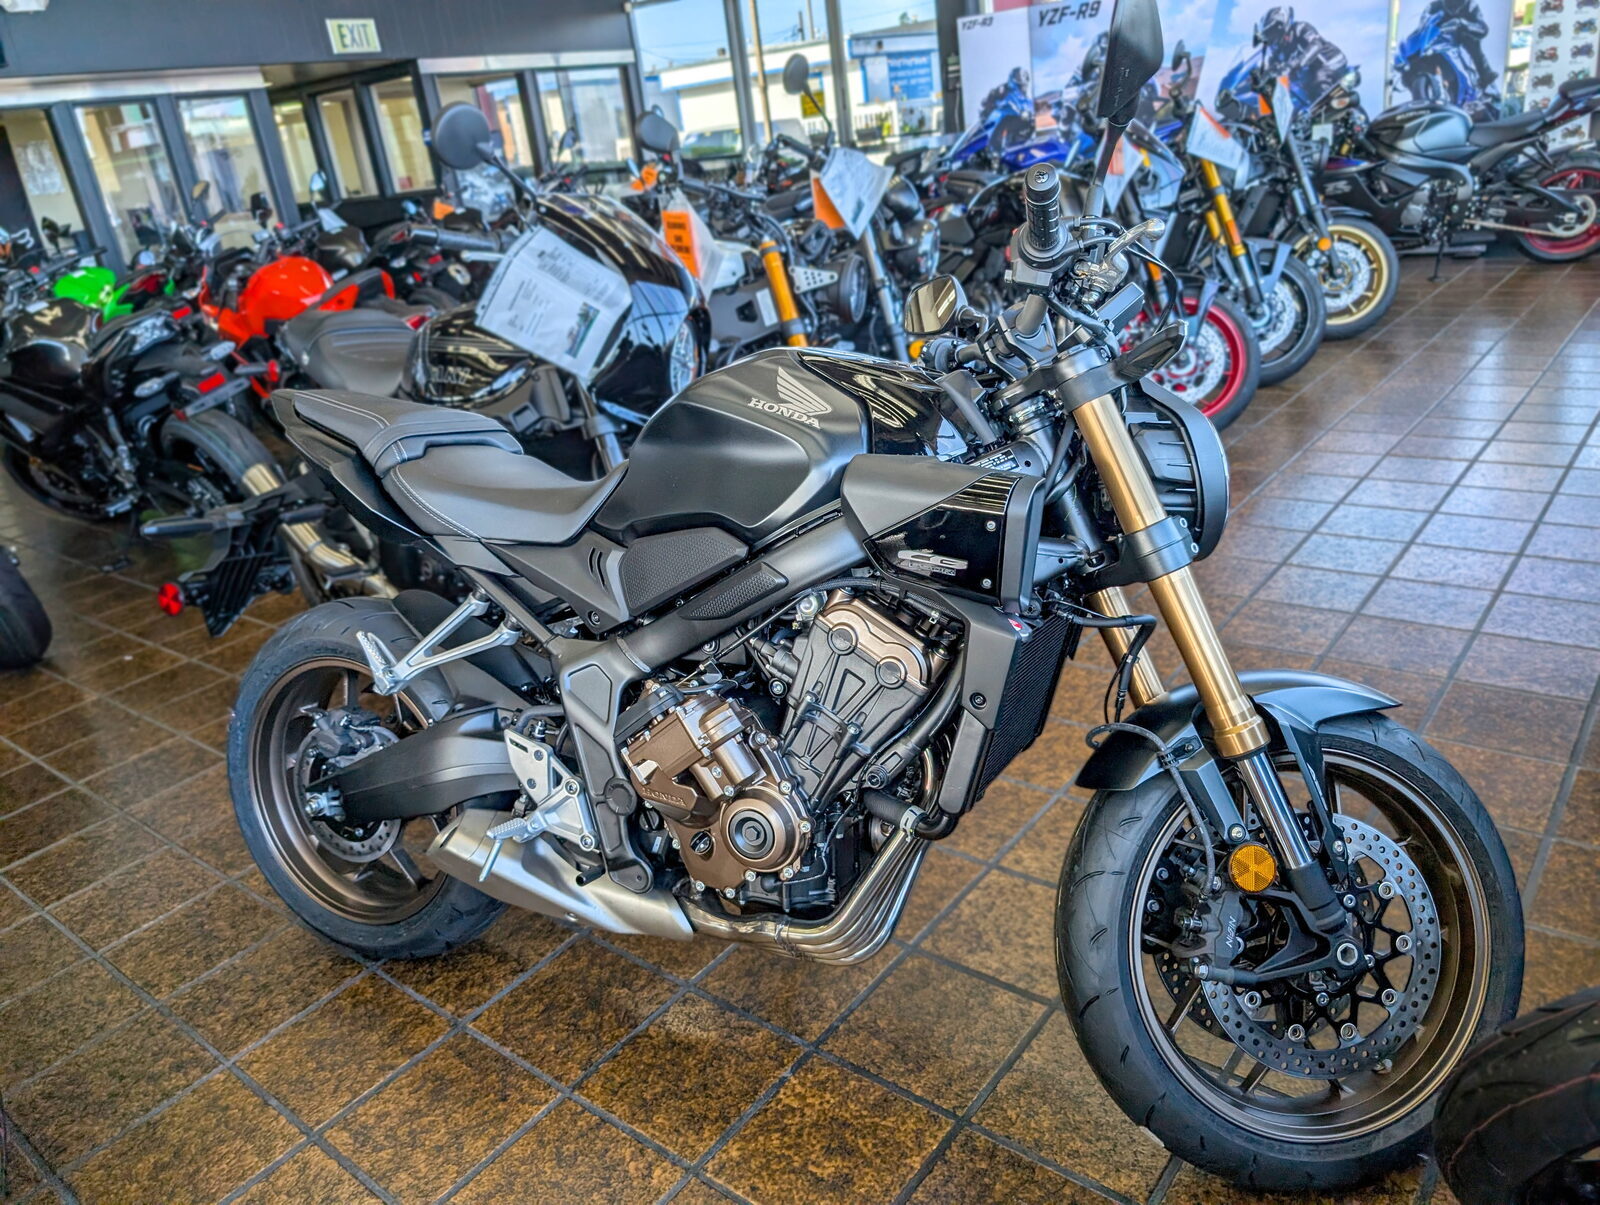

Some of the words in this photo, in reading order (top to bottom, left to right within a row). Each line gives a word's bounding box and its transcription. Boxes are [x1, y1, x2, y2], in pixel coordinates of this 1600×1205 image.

[1038, 1, 1101, 27] YZF-R9
[336, 23, 371, 48] EXIT
[747, 397, 821, 429] HONDA
